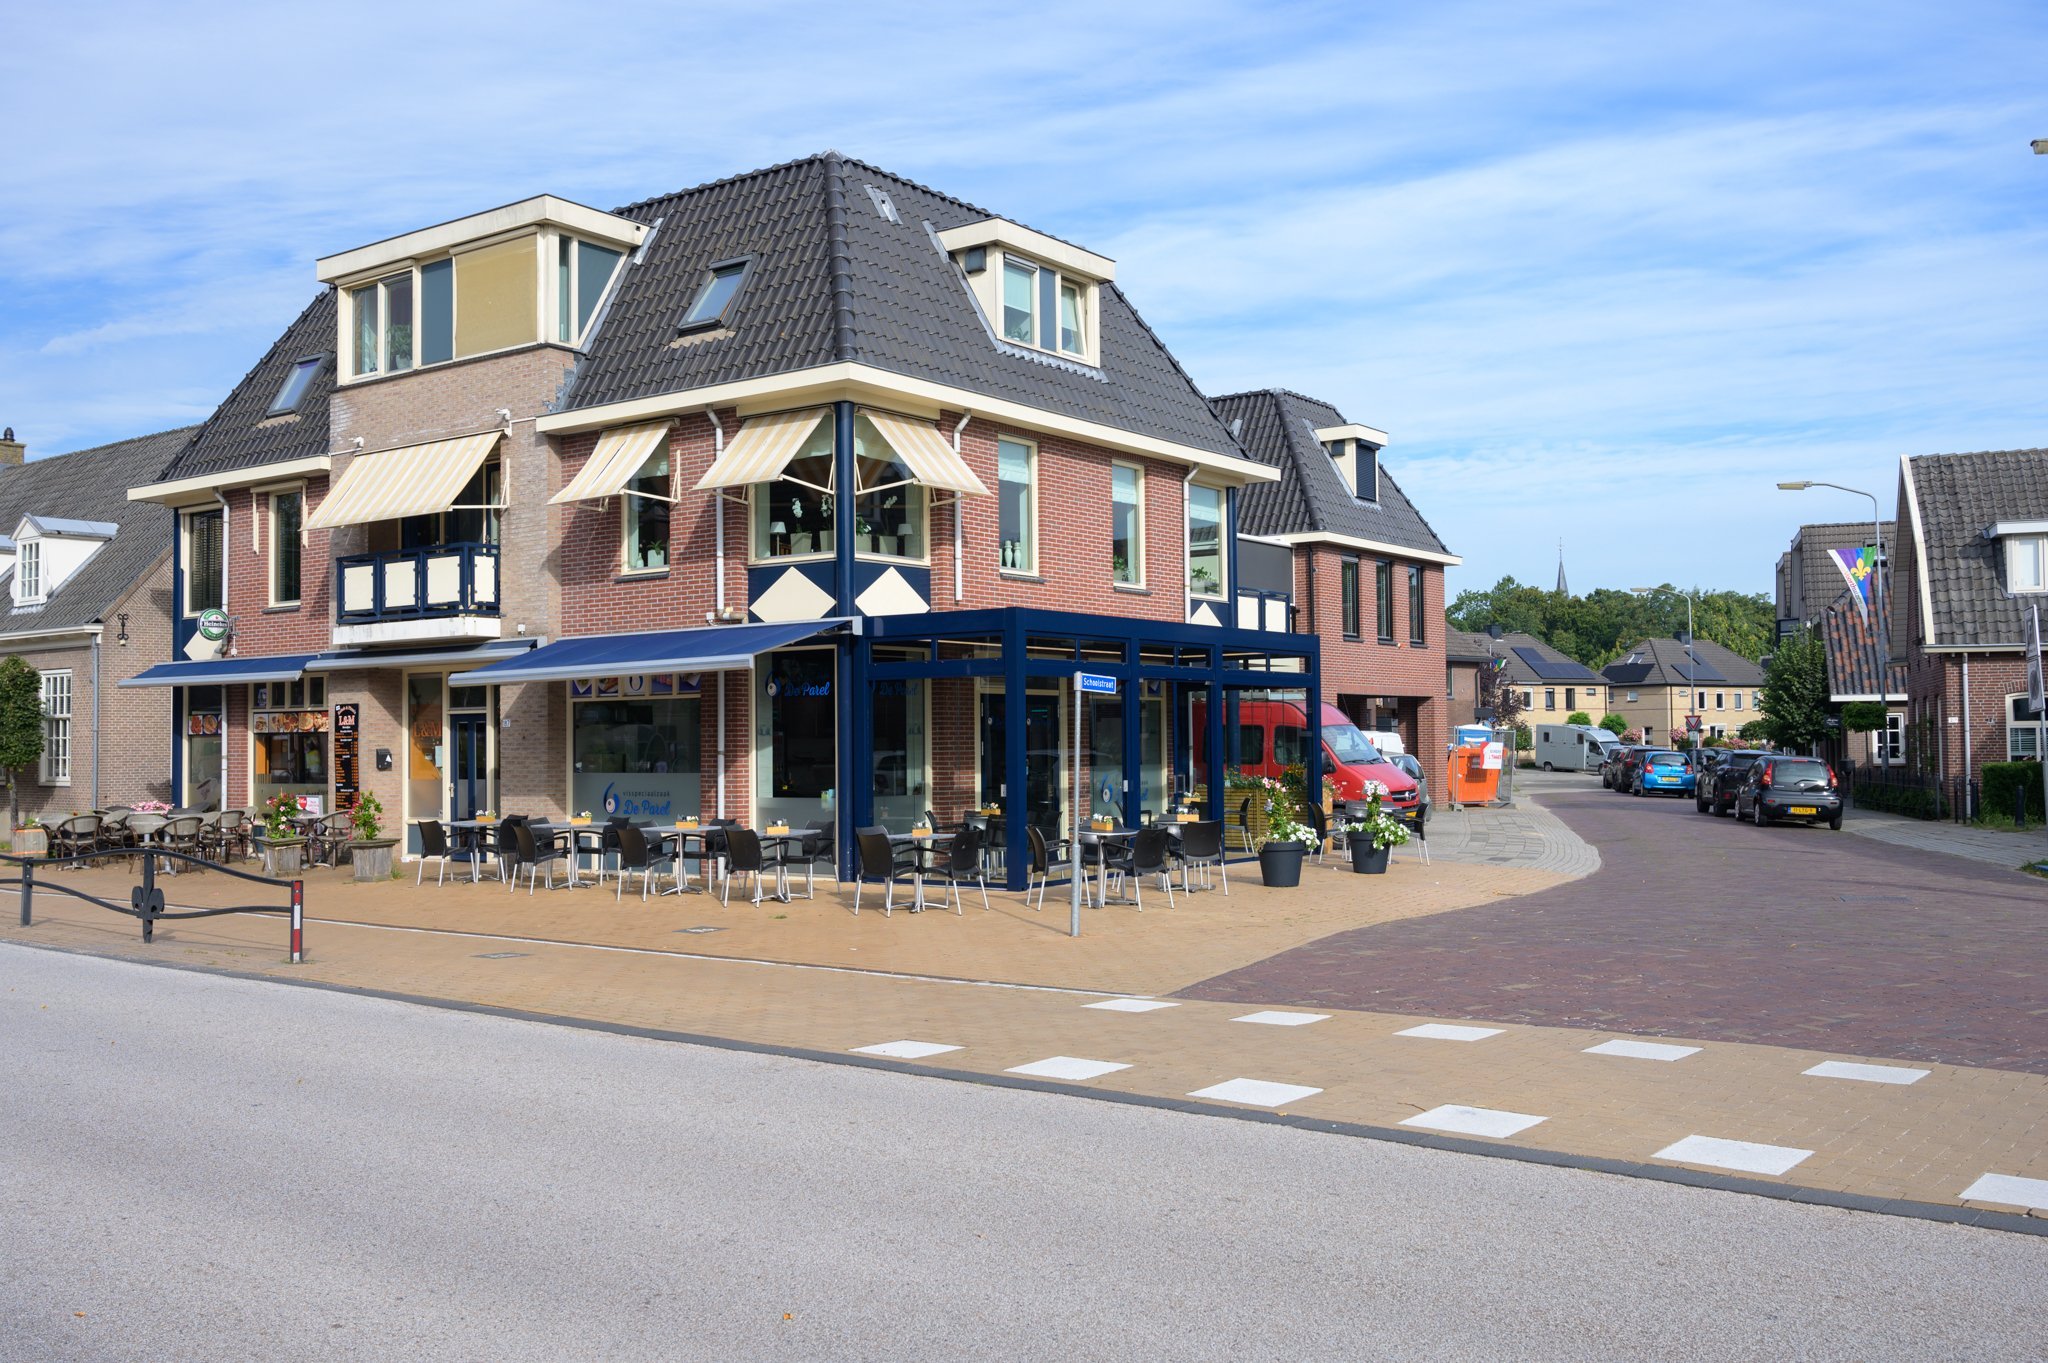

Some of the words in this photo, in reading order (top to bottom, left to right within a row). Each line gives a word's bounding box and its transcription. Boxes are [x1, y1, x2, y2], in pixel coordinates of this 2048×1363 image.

[801, 681, 831, 696] Parel
[1083, 677, 1114, 689] Schoolstraat
[338, 715, 355, 726] L&M
[623, 799, 639, 815] De
[641, 799, 671, 816] Parel
